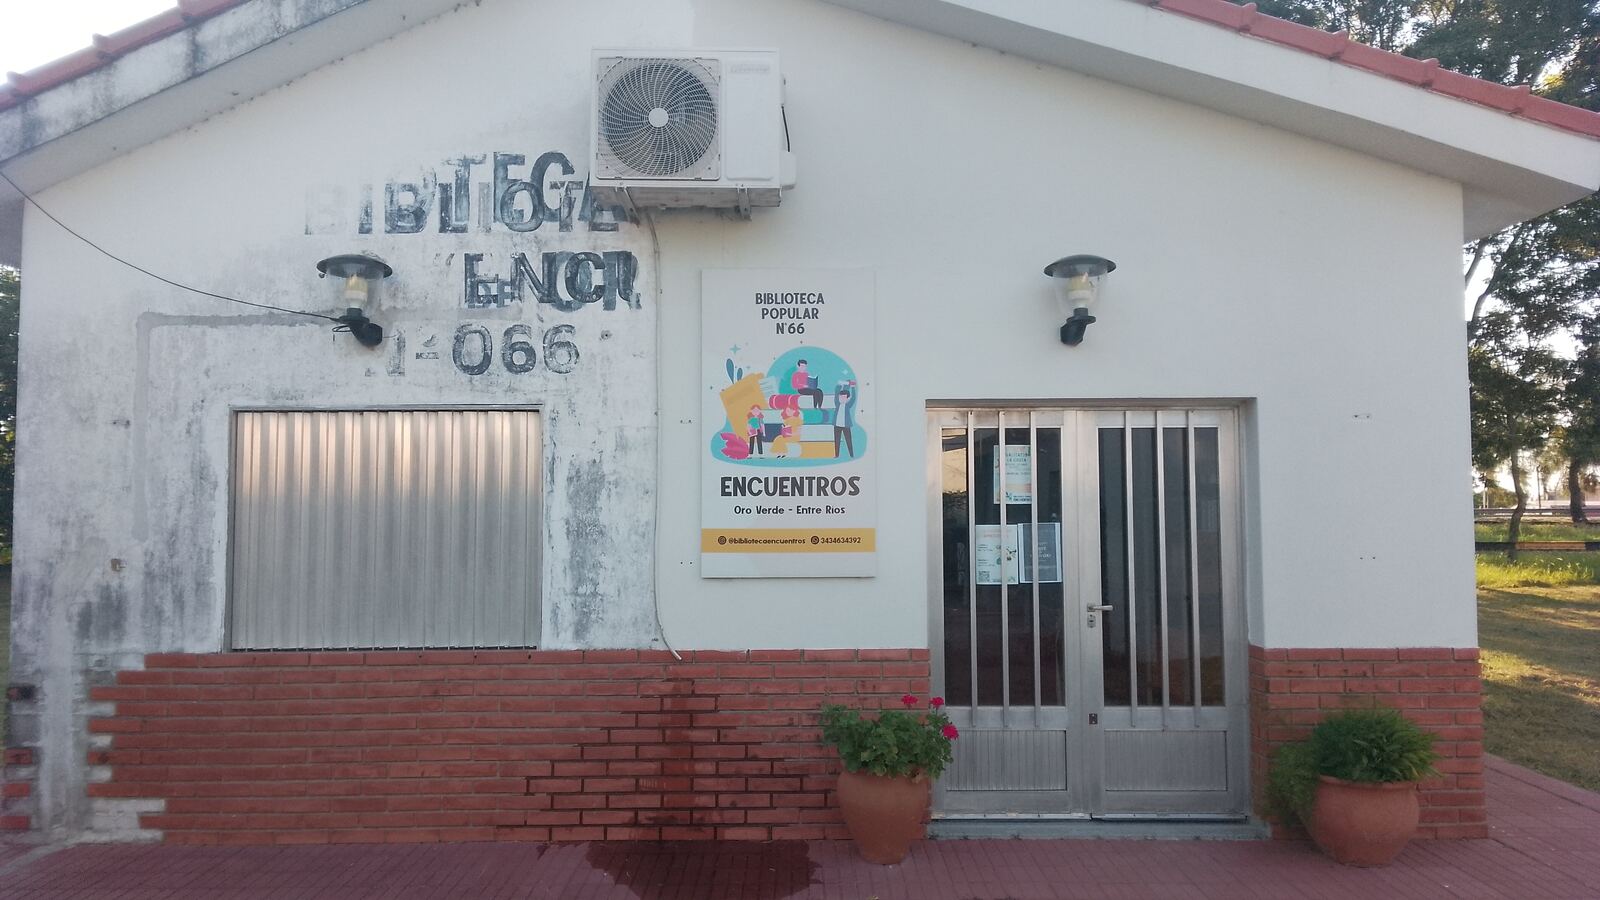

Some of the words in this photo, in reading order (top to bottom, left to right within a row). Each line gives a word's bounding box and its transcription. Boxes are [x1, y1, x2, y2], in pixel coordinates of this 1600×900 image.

[755, 292, 825, 305] BIBLIOTECA
[761, 307, 819, 320] POPULAR
[720, 475, 861, 497] ENCUENTROS
[733, 505, 752, 515] Oro
[756, 505, 785, 515] Verde
[796, 505, 822, 515] Entre
[728, 536, 806, 545] @bibliotecaencuentros
